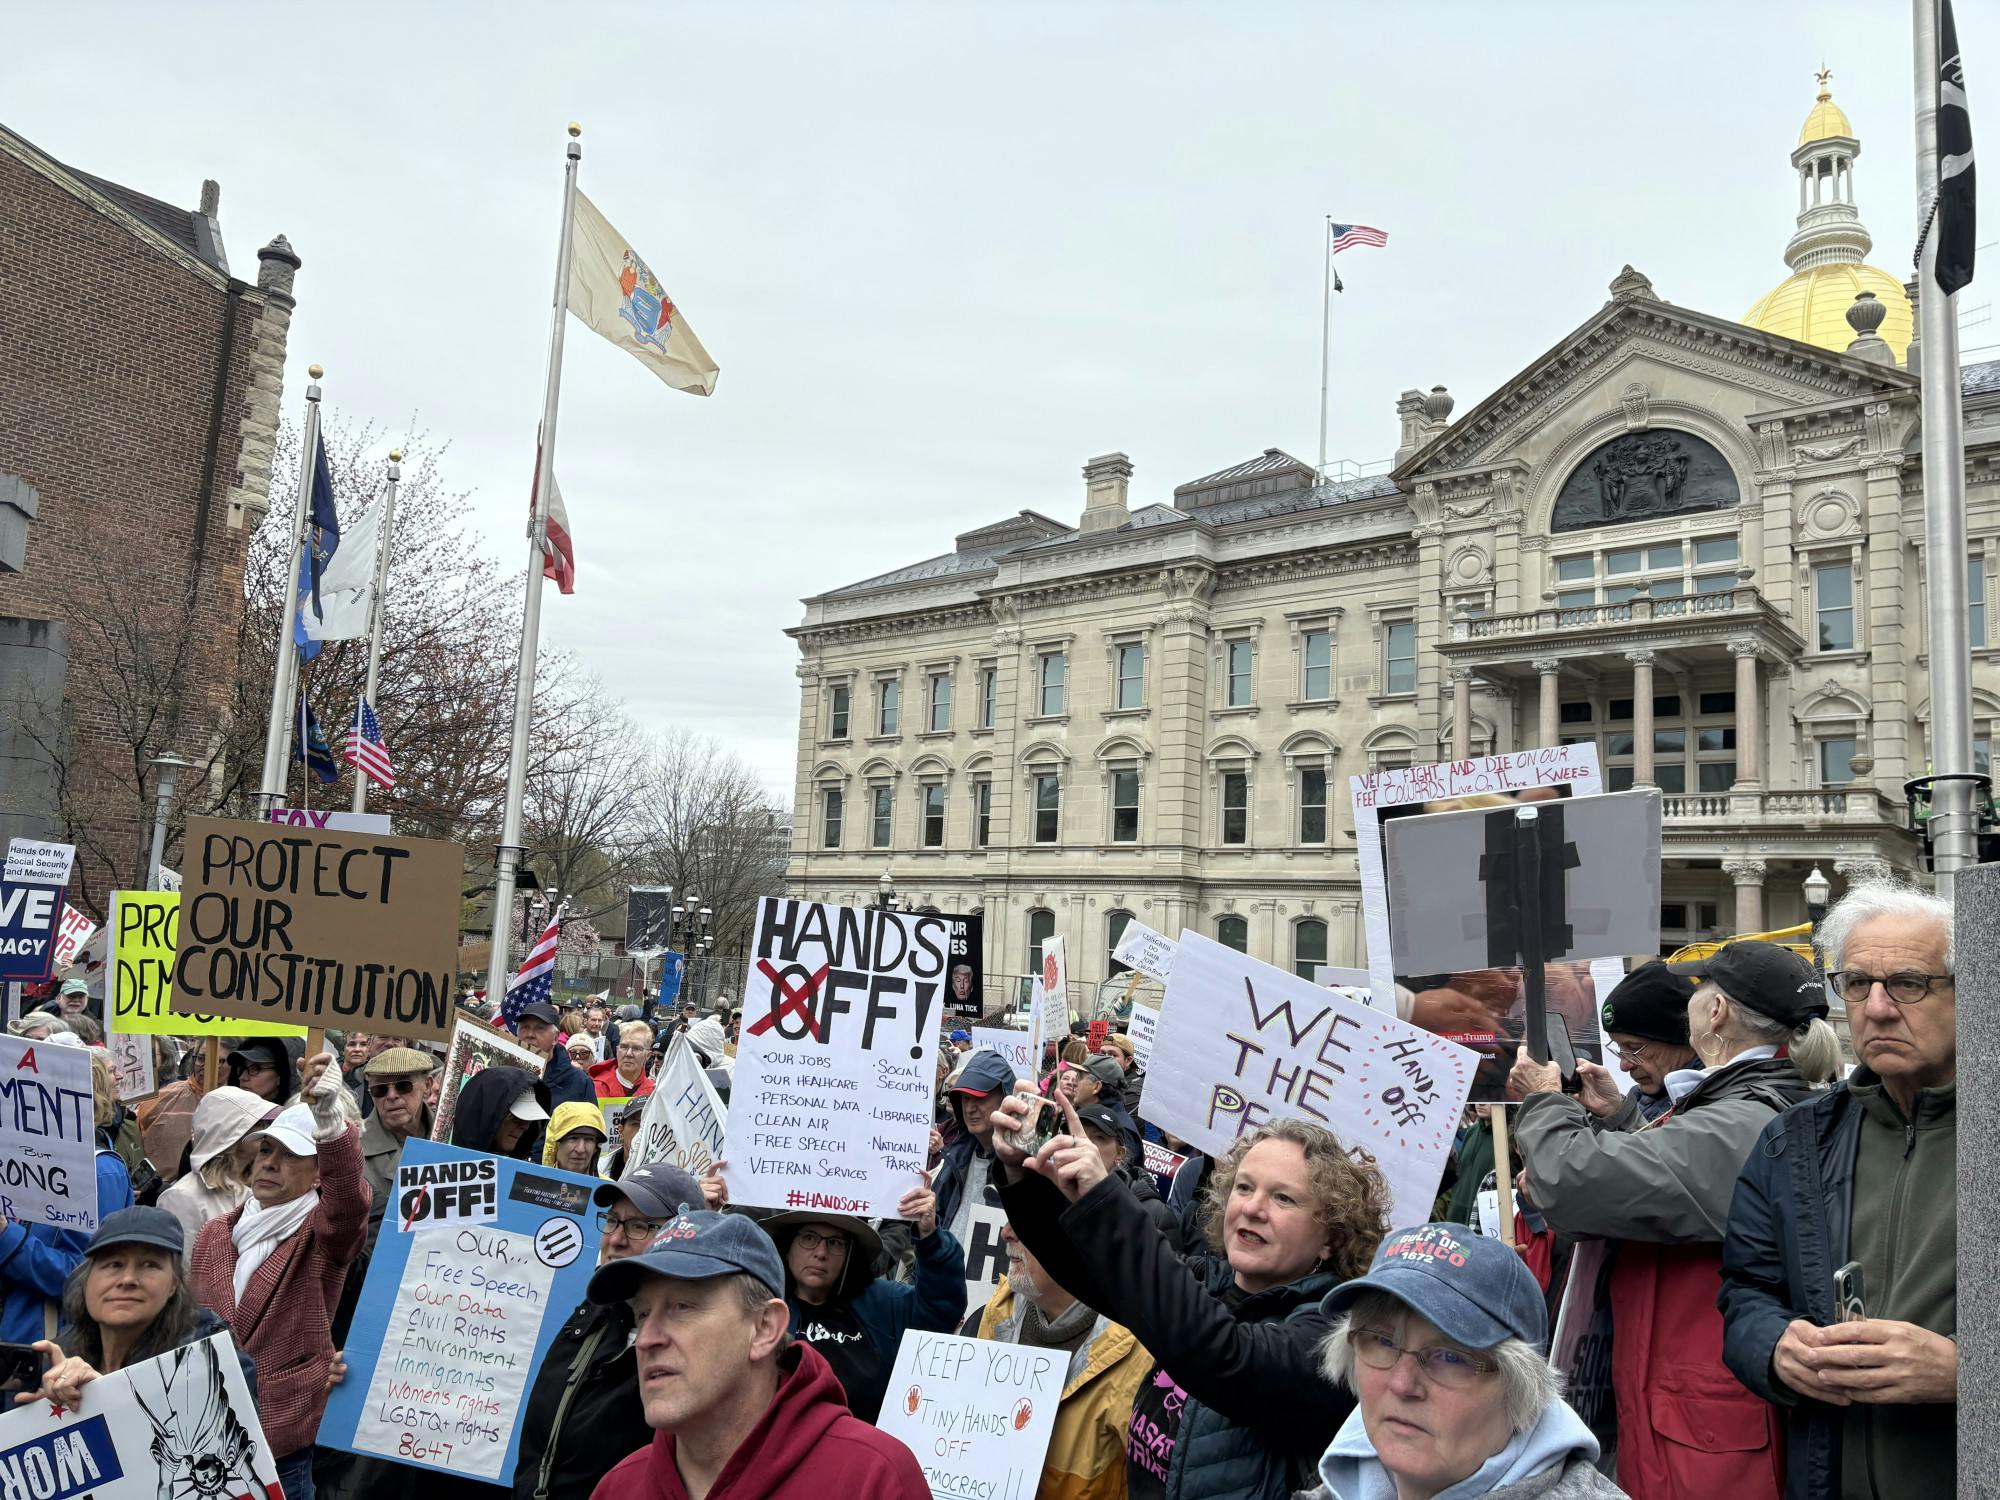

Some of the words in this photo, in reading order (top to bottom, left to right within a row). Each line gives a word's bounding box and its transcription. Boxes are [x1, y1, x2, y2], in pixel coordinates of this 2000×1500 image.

[1403, 764, 1440, 783] FIGHT
[1450, 759, 1476, 776] AND
[1486, 755, 1513, 773] DIE
[1516, 750, 1537, 769] ON
[1540, 746, 1569, 763] OUR
[1356, 789, 1378, 808] FEET
[1384, 778, 1446, 805] COWARDS
[1536, 766, 1590, 783] KNEES
[8, 856, 34, 867] Social
[36, 860, 68, 871] Security
[10, 845, 37, 856] Hands
[38, 848, 51, 857] Off
[53, 849, 66, 860] My
[202, 833, 410, 904] PROTECT
[6, 867, 23, 877] and
[25, 868, 64, 881] Medicare!
[189, 891, 293, 951] OUR
[757, 896, 946, 979] HANDS
[771, 963, 939, 1060] OFF!
[964, 1004, 978, 1013] TICK
[1244, 975, 1363, 1075] WE
[1463, 1032, 1494, 1042] Trump
[17, 1046, 39, 1074] A
[766, 1051, 794, 1065] OUR
[798, 1054, 831, 1069] JOBS
[1383, 1038, 1440, 1105] HANDS
[763, 1074, 790, 1086] OUR
[1225, 1032, 1334, 1122] THE
[761, 1091, 829, 1109] PERSONAL
[833, 1099, 861, 1112] DATA
[872, 1106, 930, 1125] LIBRARIES
[754, 1113, 801, 1127] CLEAN
[807, 1117, 830, 1132] AIR
[754, 1133, 792, 1149] FREE
[798, 1136, 846, 1153] SPEECH
[400, 1159, 496, 1188] HANDS
[750, 1156, 812, 1176] VETERAN
[400, 1182, 496, 1224] OFF!
[785, 1189, 871, 1212] #HANDSOFF
[1384, 1240, 1467, 1268] MEXICO
[1399, 1231, 1437, 1244] GULF
[1438, 1236, 1461, 1251] OF
[1401, 1251, 1435, 1264] 1672
[424, 1250, 464, 1285] Free
[470, 1265, 538, 1303] Speech
[414, 1283, 453, 1307] Our
[458, 1294, 509, 1320] Data
[408, 1307, 449, 1331] Civil
[454, 1316, 507, 1348] Rights
[402, 1328, 517, 1370] Environment
[911, 1335, 976, 1382] KEEP
[984, 1345, 1051, 1393] YOUR
[394, 1350, 496, 1392] Immigrants
[387, 1379, 451, 1406] Women's
[456, 1394, 501, 1421] rights
[379, 1401, 450, 1432] LGBTQ+
[455, 1420, 500, 1445] rights
[921, 1398, 960, 1434] TINY
[961, 1404, 1008, 1437] HANDS
[398, 1432, 454, 1465] 8647
[934, 1437, 972, 1461] OFF
